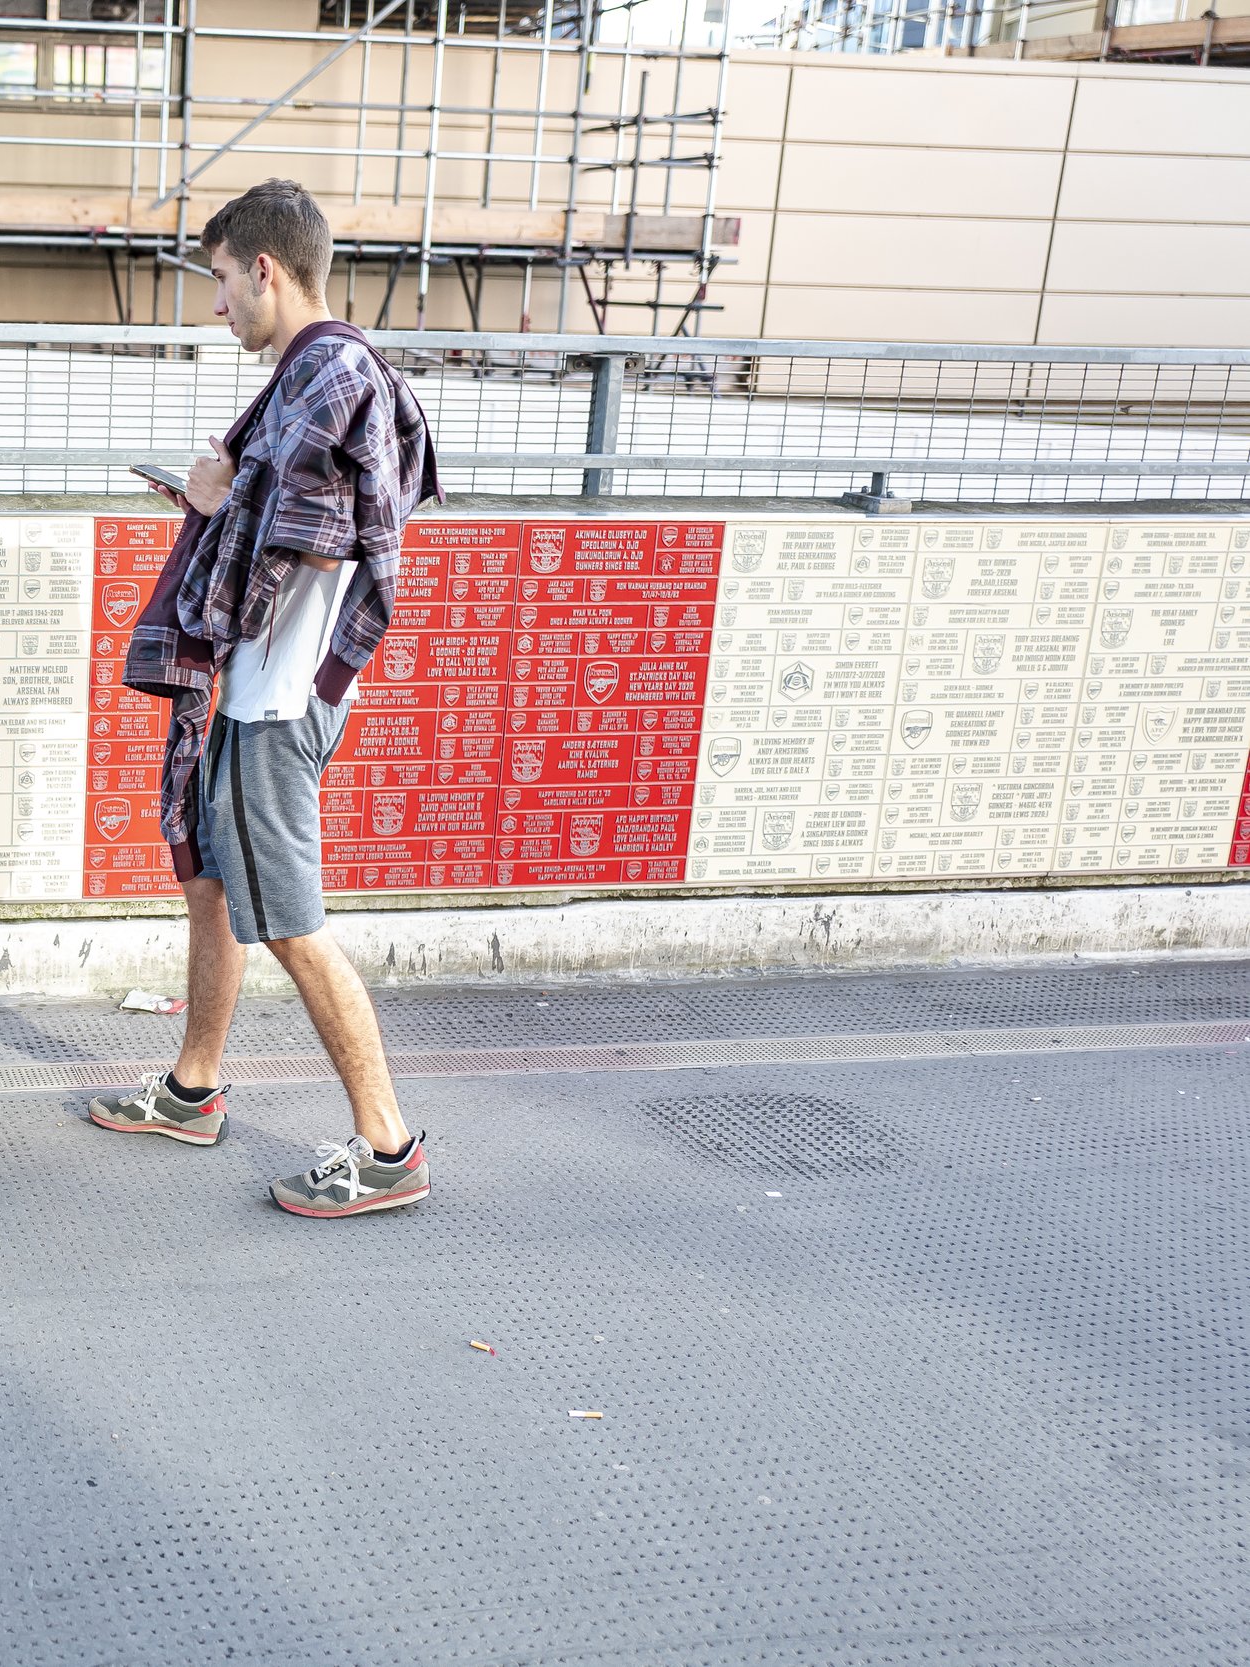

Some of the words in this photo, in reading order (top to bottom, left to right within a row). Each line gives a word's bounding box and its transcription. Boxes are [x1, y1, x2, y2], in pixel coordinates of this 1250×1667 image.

[10, 666, 40, 674] MATTHEW
[20, 676, 51, 684] BROTHER,
[54, 676, 73, 684] UNCLE
[17, 687, 44, 695] ARSENAL
[3, 698, 28, 706] ALWAYS
[31, 697, 72, 705] REMEMBERED
